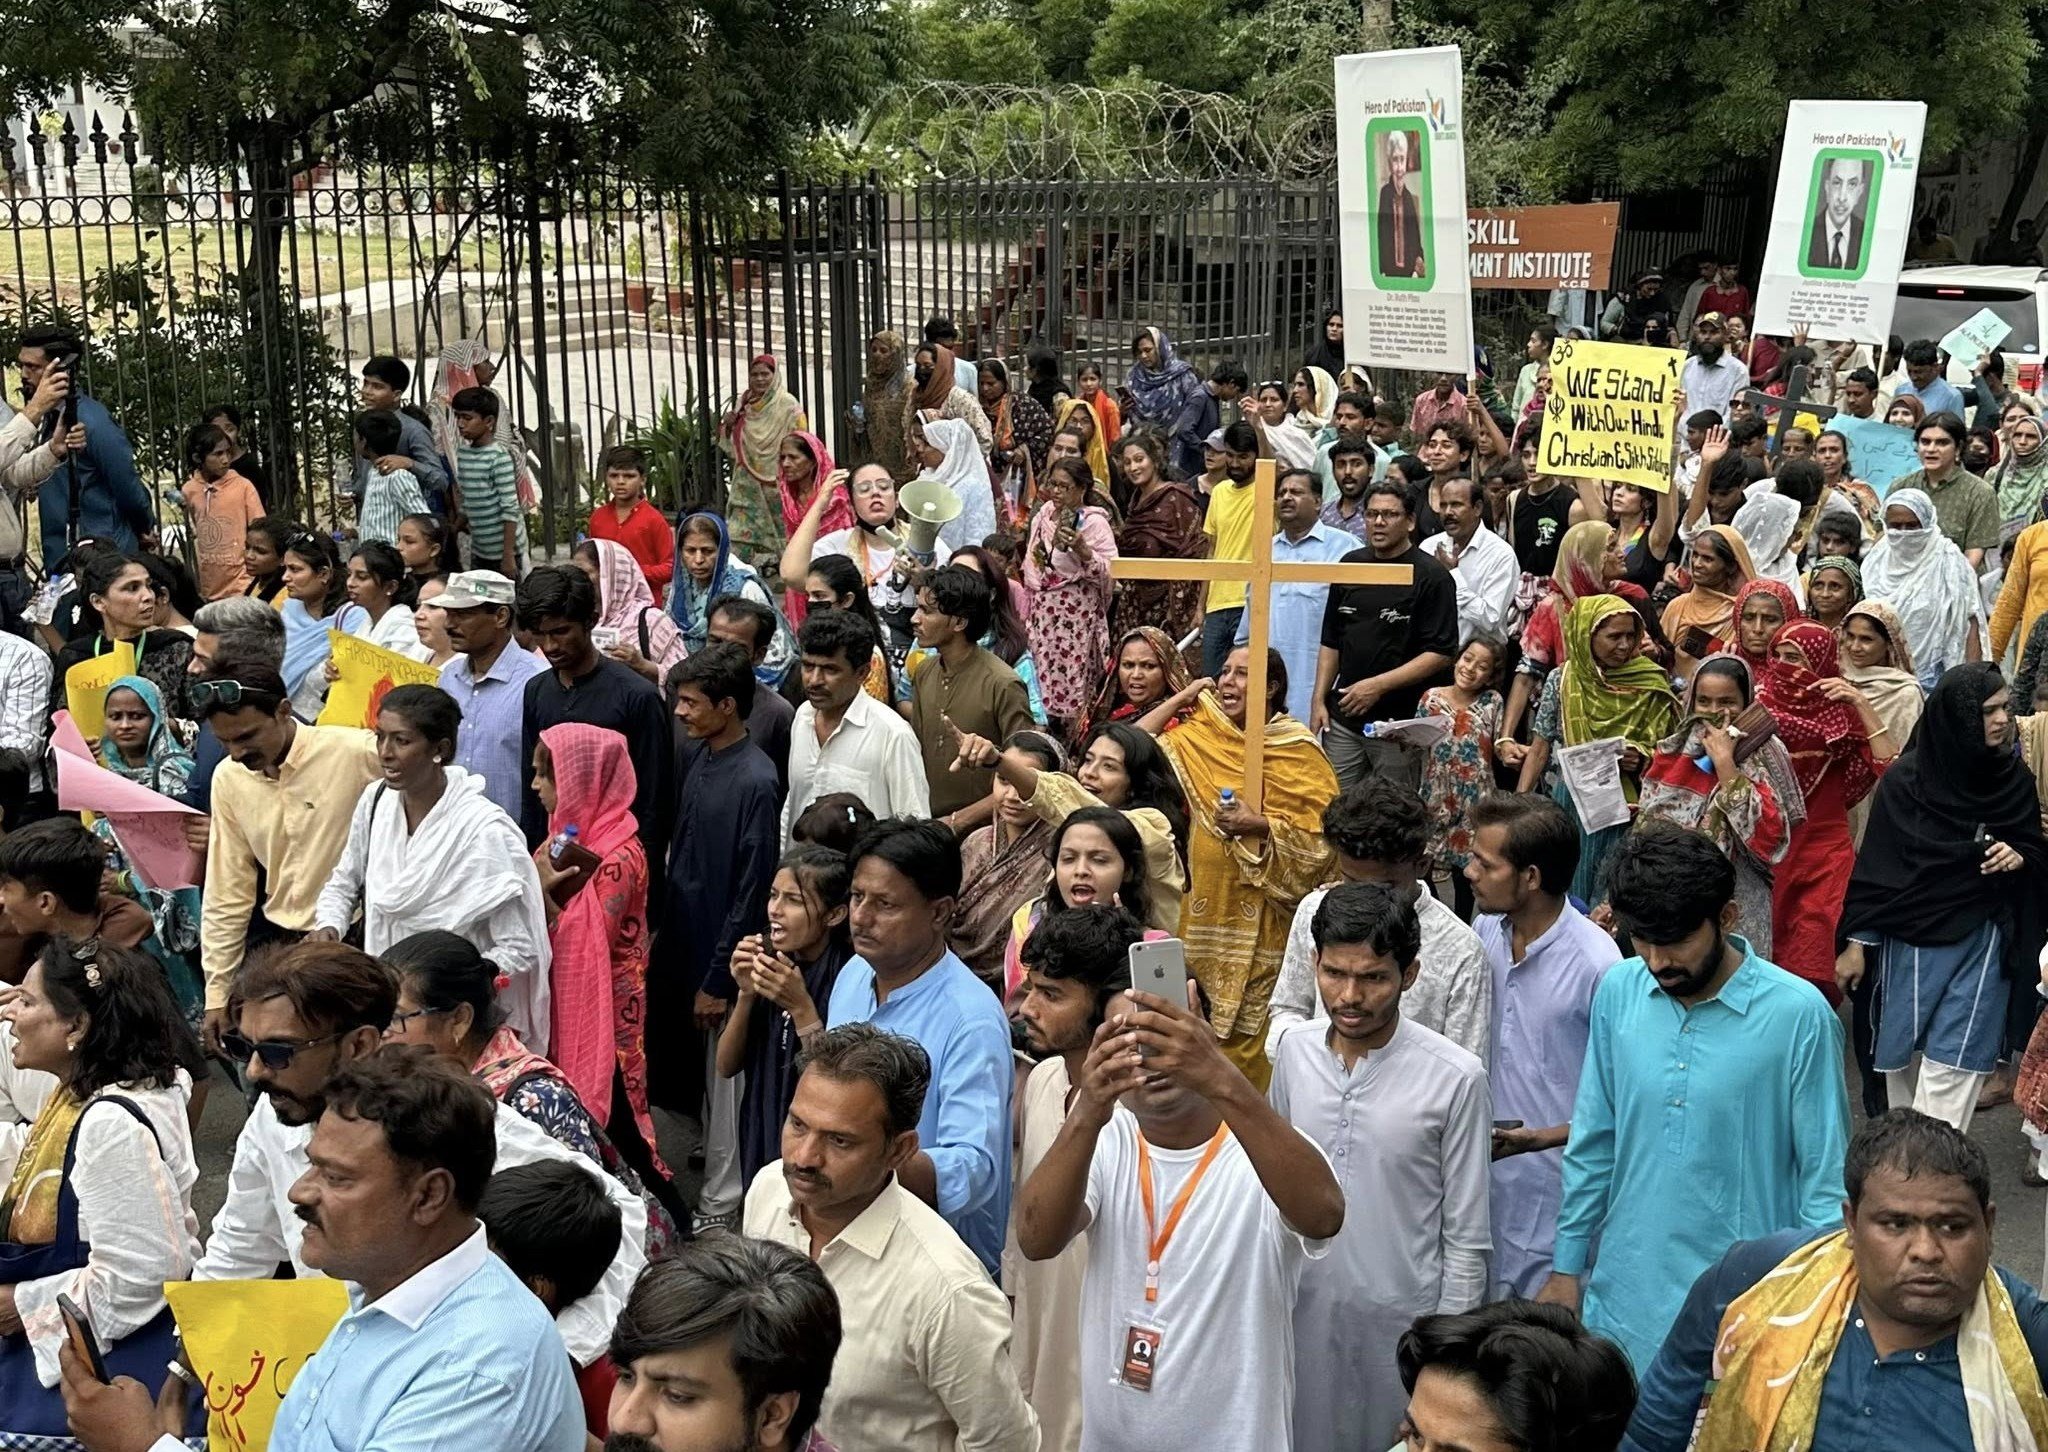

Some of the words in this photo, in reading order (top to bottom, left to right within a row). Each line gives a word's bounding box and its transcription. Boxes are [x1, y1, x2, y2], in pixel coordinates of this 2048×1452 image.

[1365, 101, 1382, 114] Hero
[1383, 100, 1391, 114] of
[1392, 98, 1426, 113] Pakistan
[1812, 133, 1834, 145] Hero
[1836, 133, 1846, 145] of
[1846, 134, 1887, 147] Pakistan
[1468, 219, 1519, 245] SKILL
[1508, 252, 1592, 279] INSTITUTE
[1567, 366, 1601, 399] WE
[1604, 368, 1666, 404] Stand
[1547, 431, 1614, 468] Christian
[1624, 442, 1646, 470] Sikh
